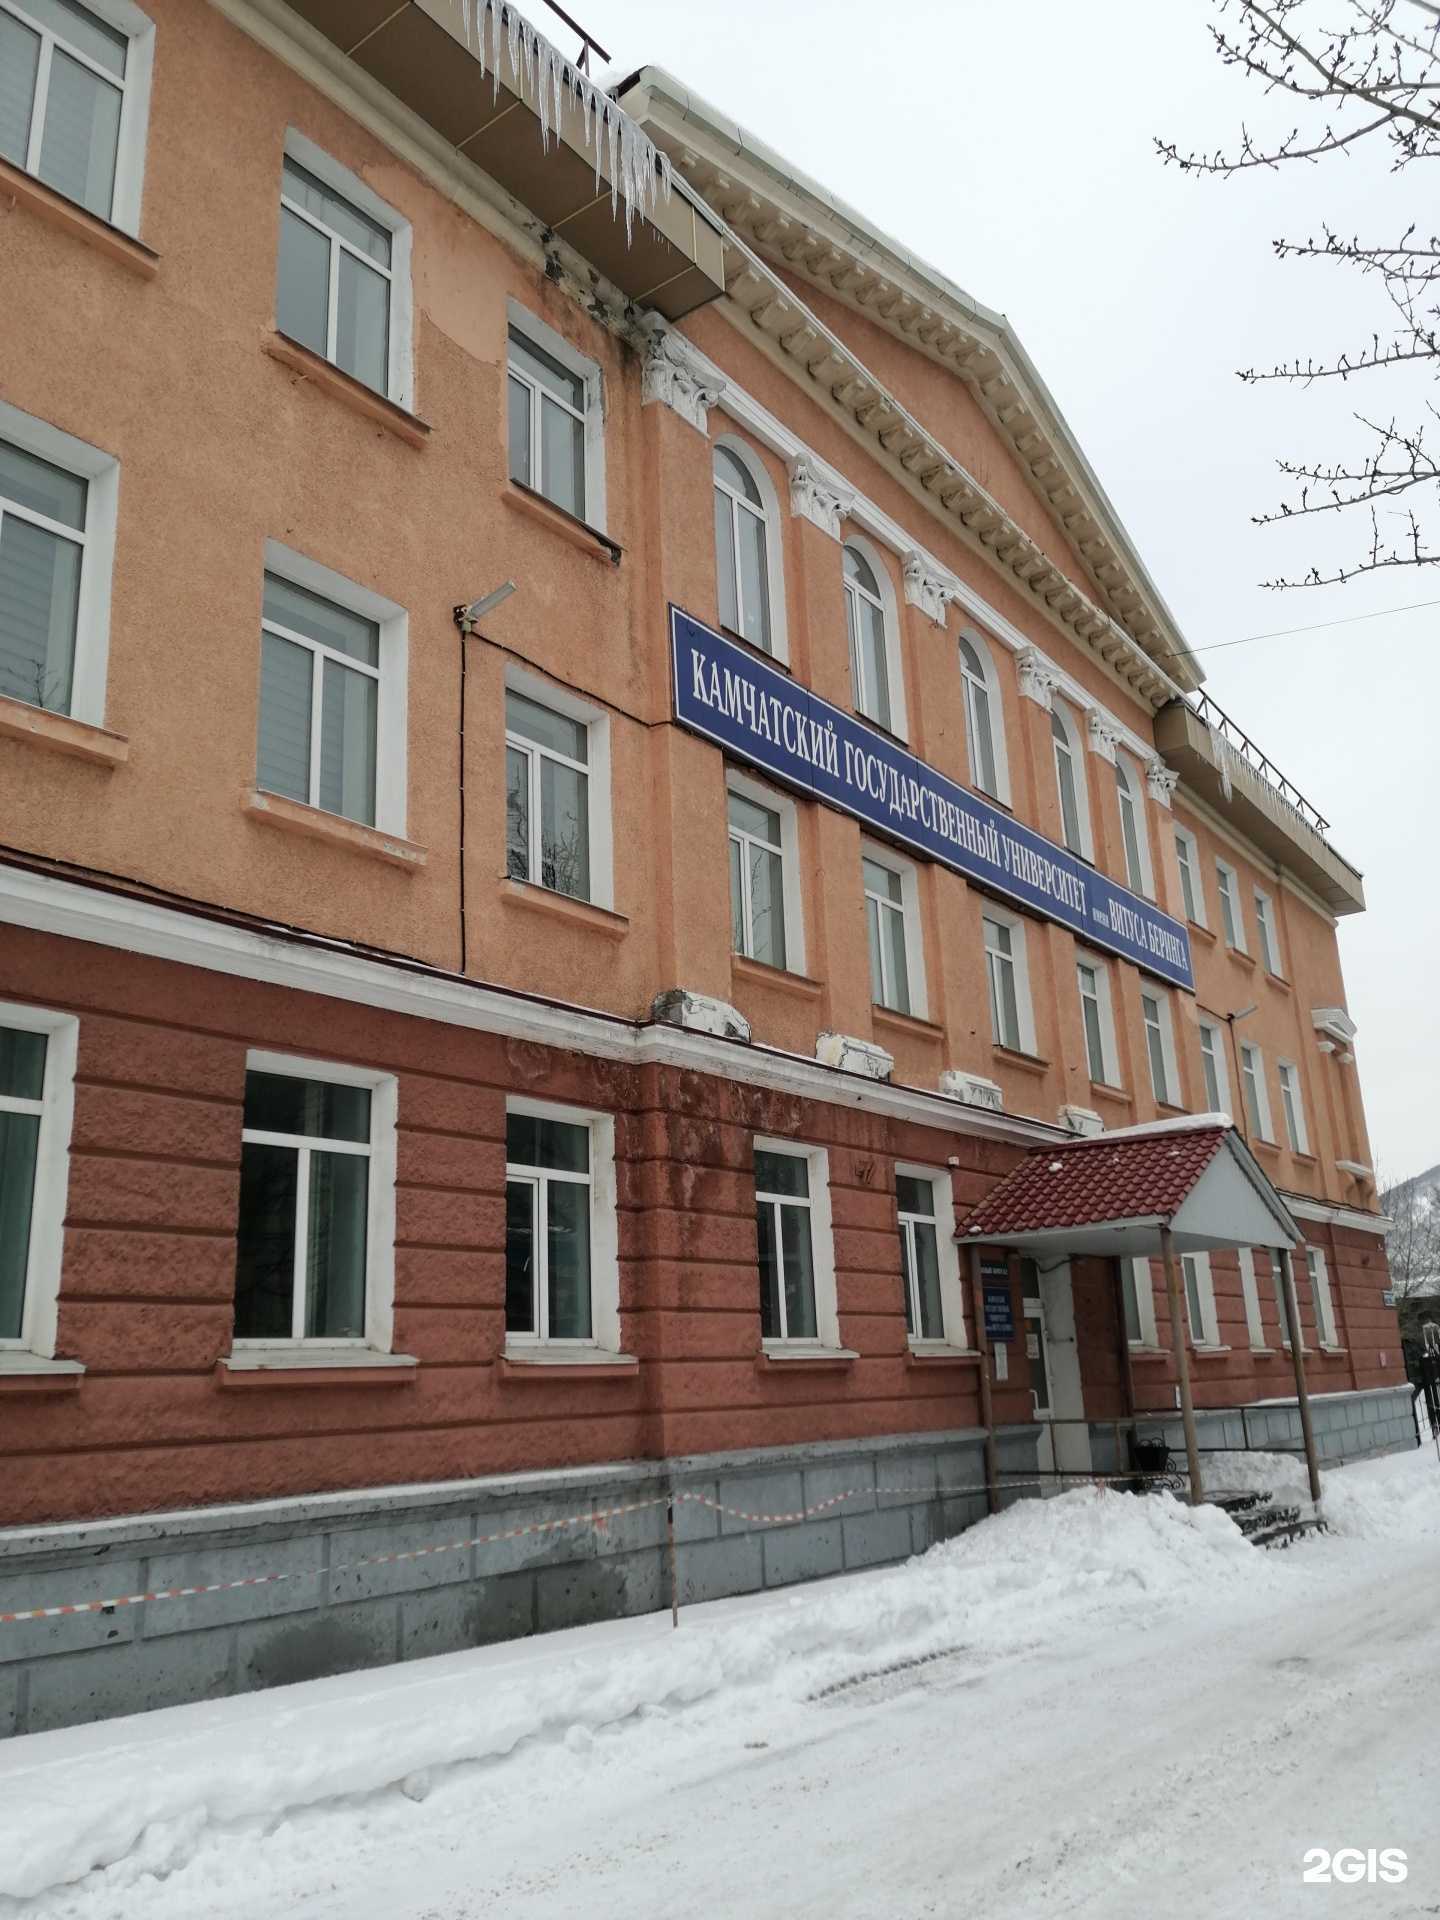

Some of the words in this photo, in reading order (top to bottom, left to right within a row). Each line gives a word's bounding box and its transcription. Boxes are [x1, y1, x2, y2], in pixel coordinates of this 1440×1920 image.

[691, 648, 840, 779] КАМЧАТСКИЙ
[844, 740, 1002, 868] ГОСУДАРСТВЕННЫЙ
[1001, 834, 1087, 916] УНИВЕРСИТЕТ
[1108, 898, 1149, 950] ВИТУСА
[1146, 920, 1189, 972] БЕРИНГА
